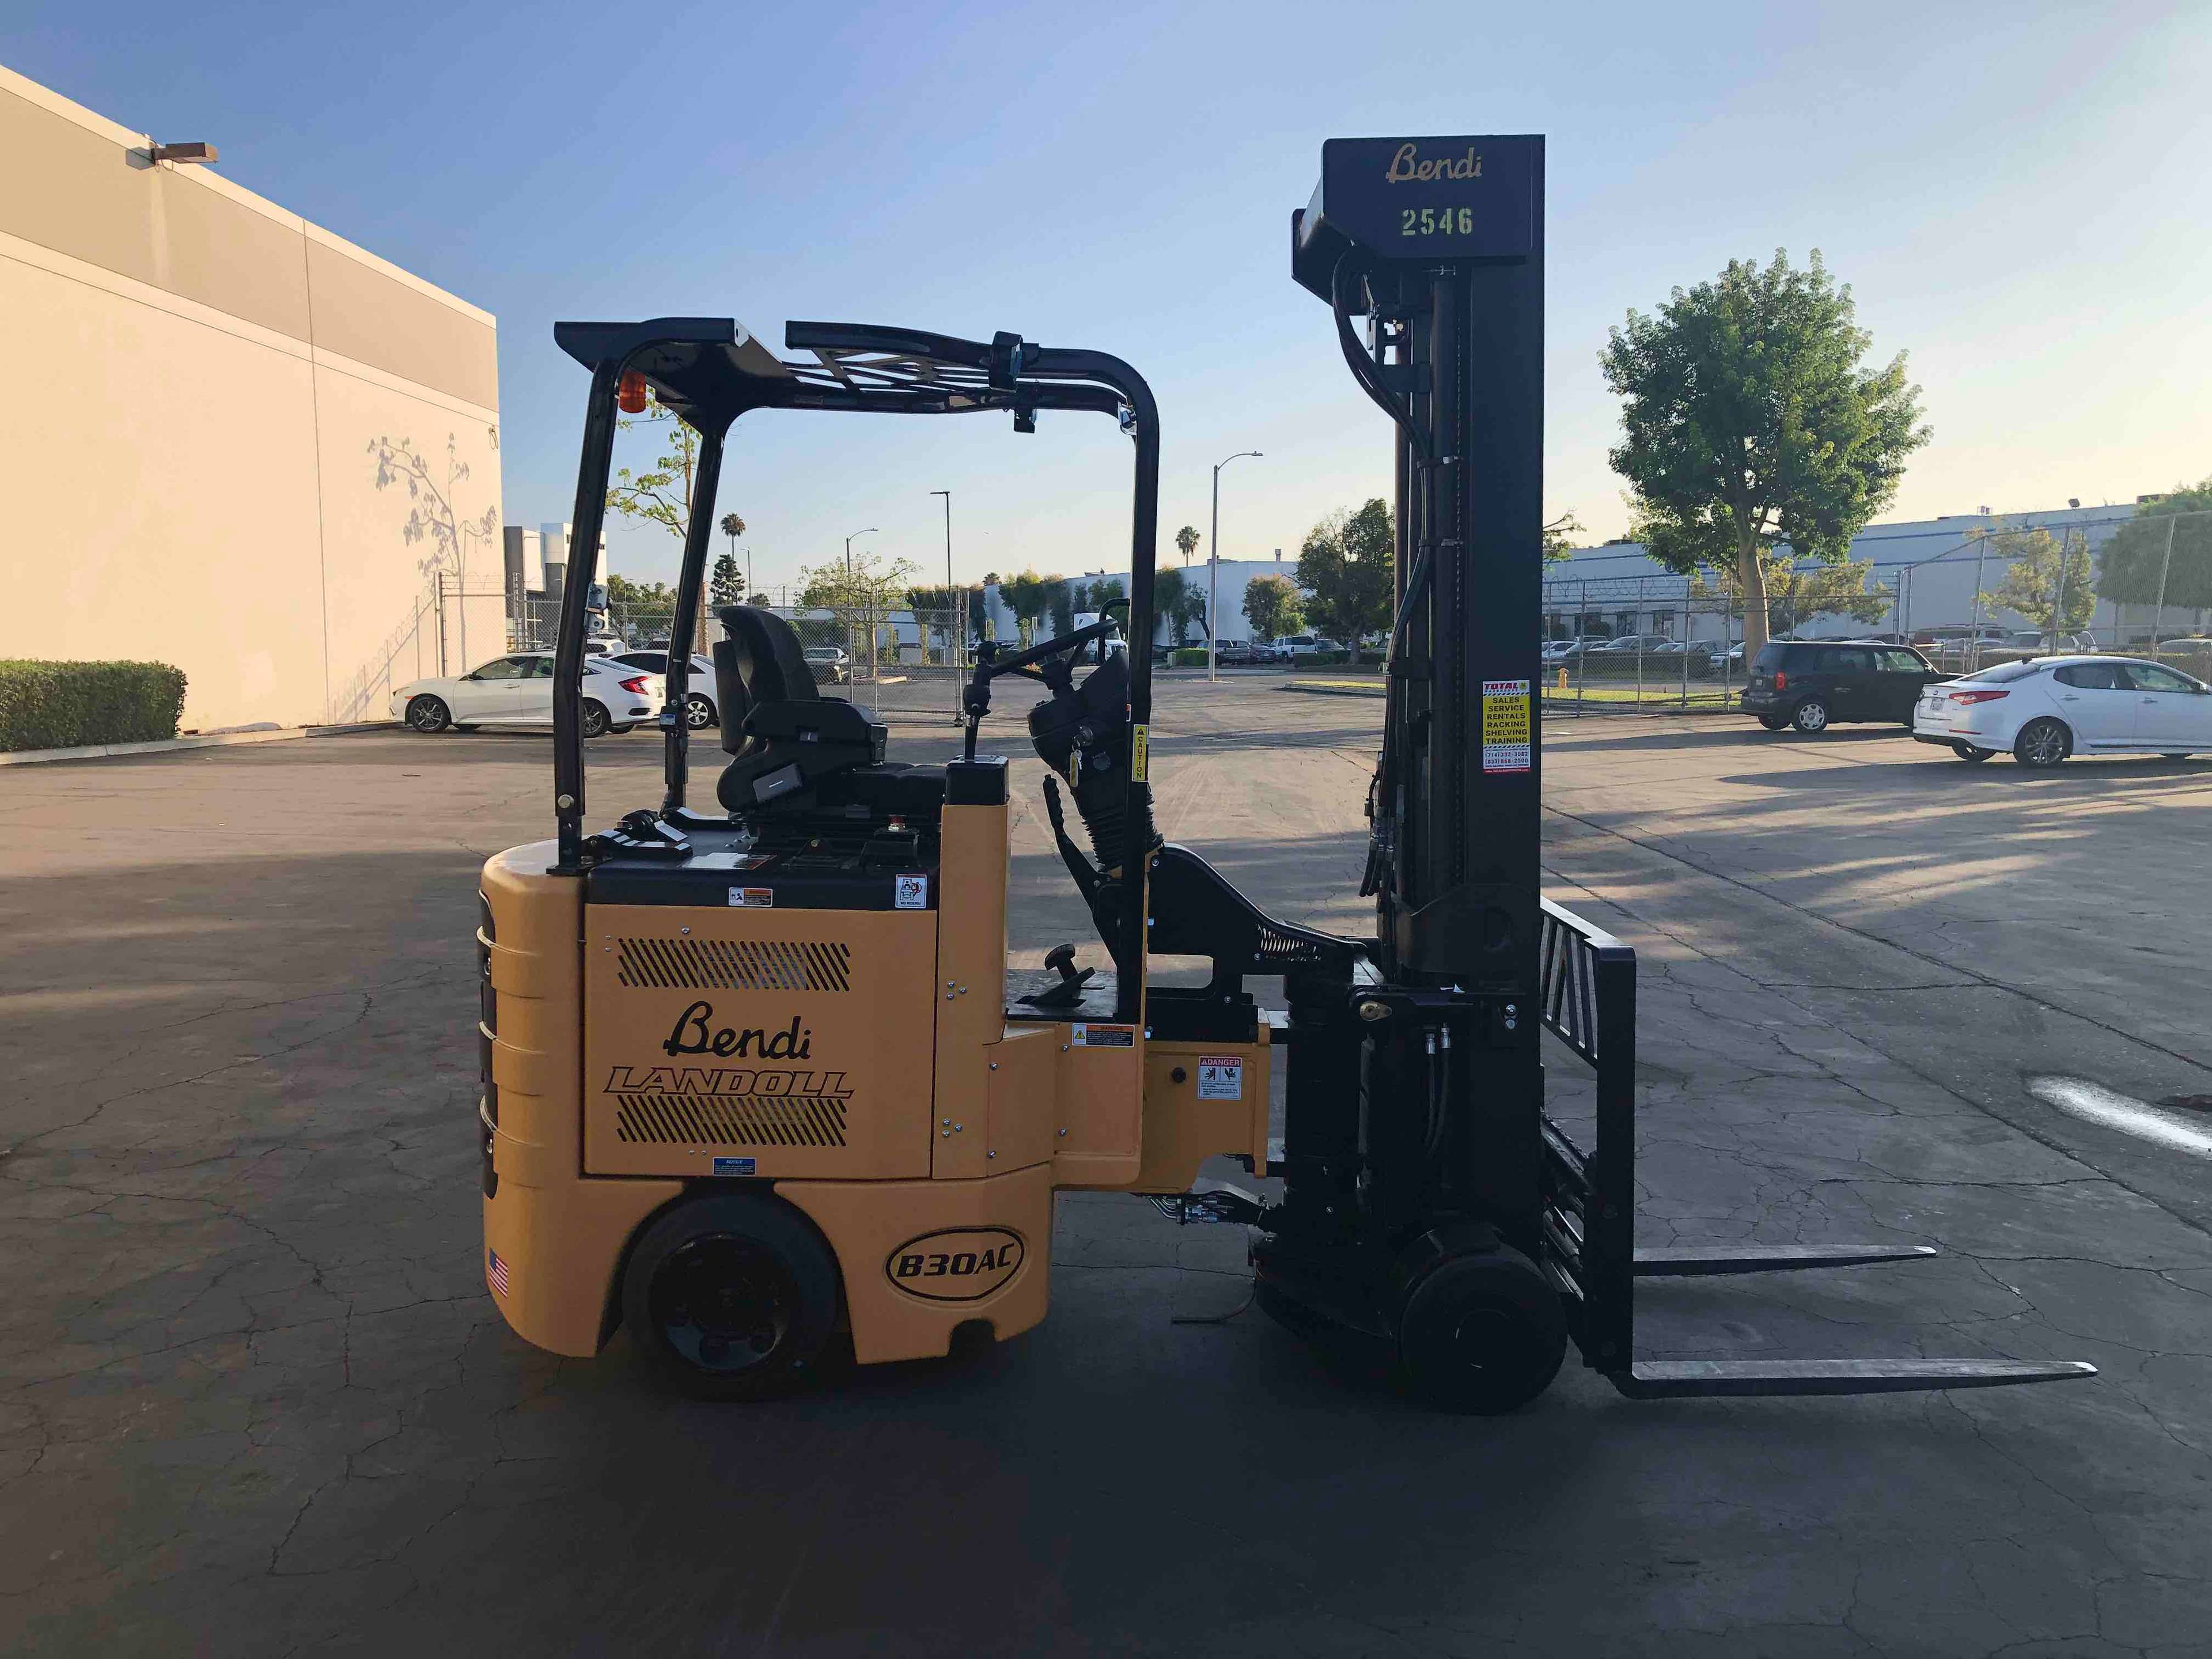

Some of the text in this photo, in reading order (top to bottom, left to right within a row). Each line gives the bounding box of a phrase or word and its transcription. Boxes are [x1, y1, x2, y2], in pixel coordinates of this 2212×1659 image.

[1385, 143, 1483, 184] Bendi
[1402, 208, 1472, 236] 2546
[1484, 682, 1518, 690] TOTAL
[662, 1001, 812, 1060] Bendi
[603, 1066, 855, 1099] LANDOLL
[896, 1243, 1014, 1277] B30AC
